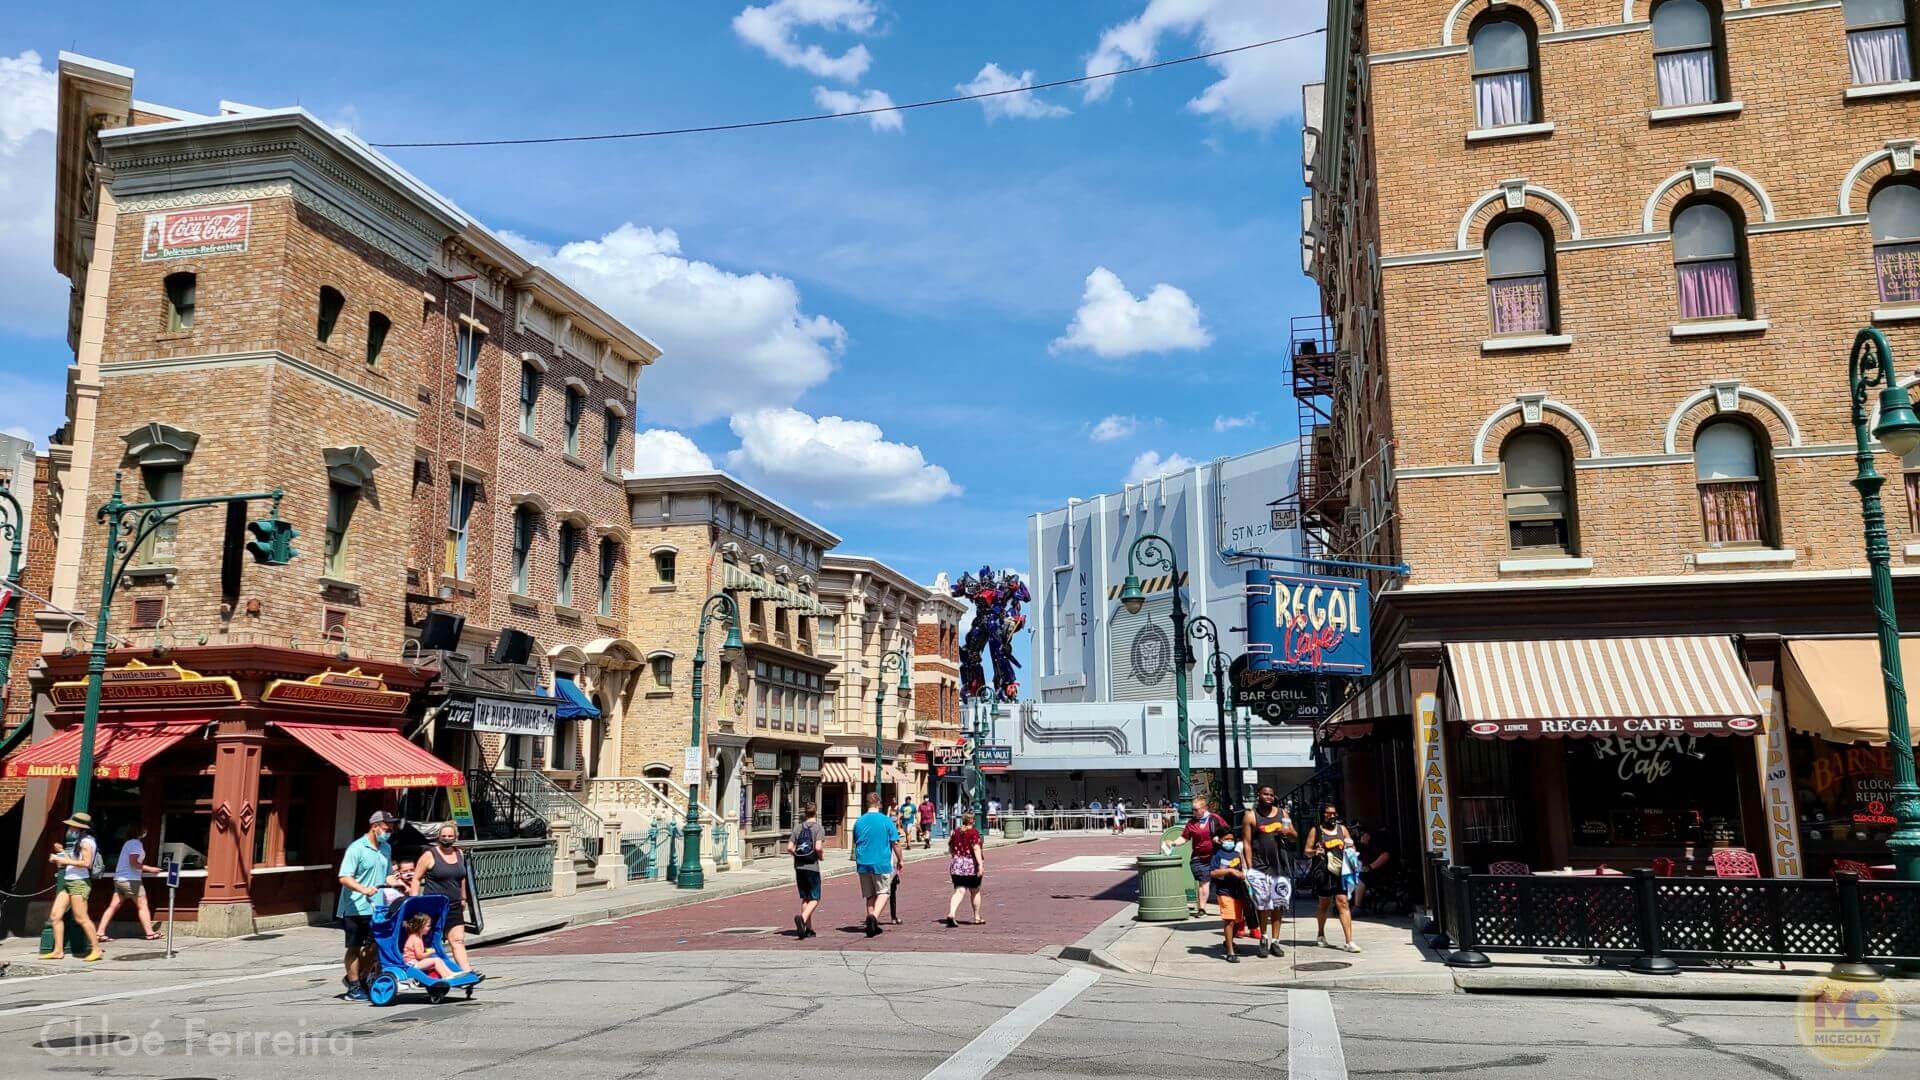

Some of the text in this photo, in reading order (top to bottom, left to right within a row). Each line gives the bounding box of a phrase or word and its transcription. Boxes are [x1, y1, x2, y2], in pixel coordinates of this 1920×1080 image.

[1275, 580, 1362, 634] REGAL
[1284, 614, 1345, 668] Cafe
[162, 683, 226, 697] PRETZELS
[447, 709, 473, 723] LIVE!
[477, 704, 541, 730] THE BLUES BROTHERS
[1540, 719, 1618, 733] REGAL
[1622, 718, 1685, 732] CAFE
[1617, 749, 1673, 784] Cafe
[1768, 769, 1787, 781] AND
[1423, 711, 1448, 853] BREAKFAS
[1857, 779, 1892, 790] CLOCK
[1771, 788, 1799, 876] LUNCH
